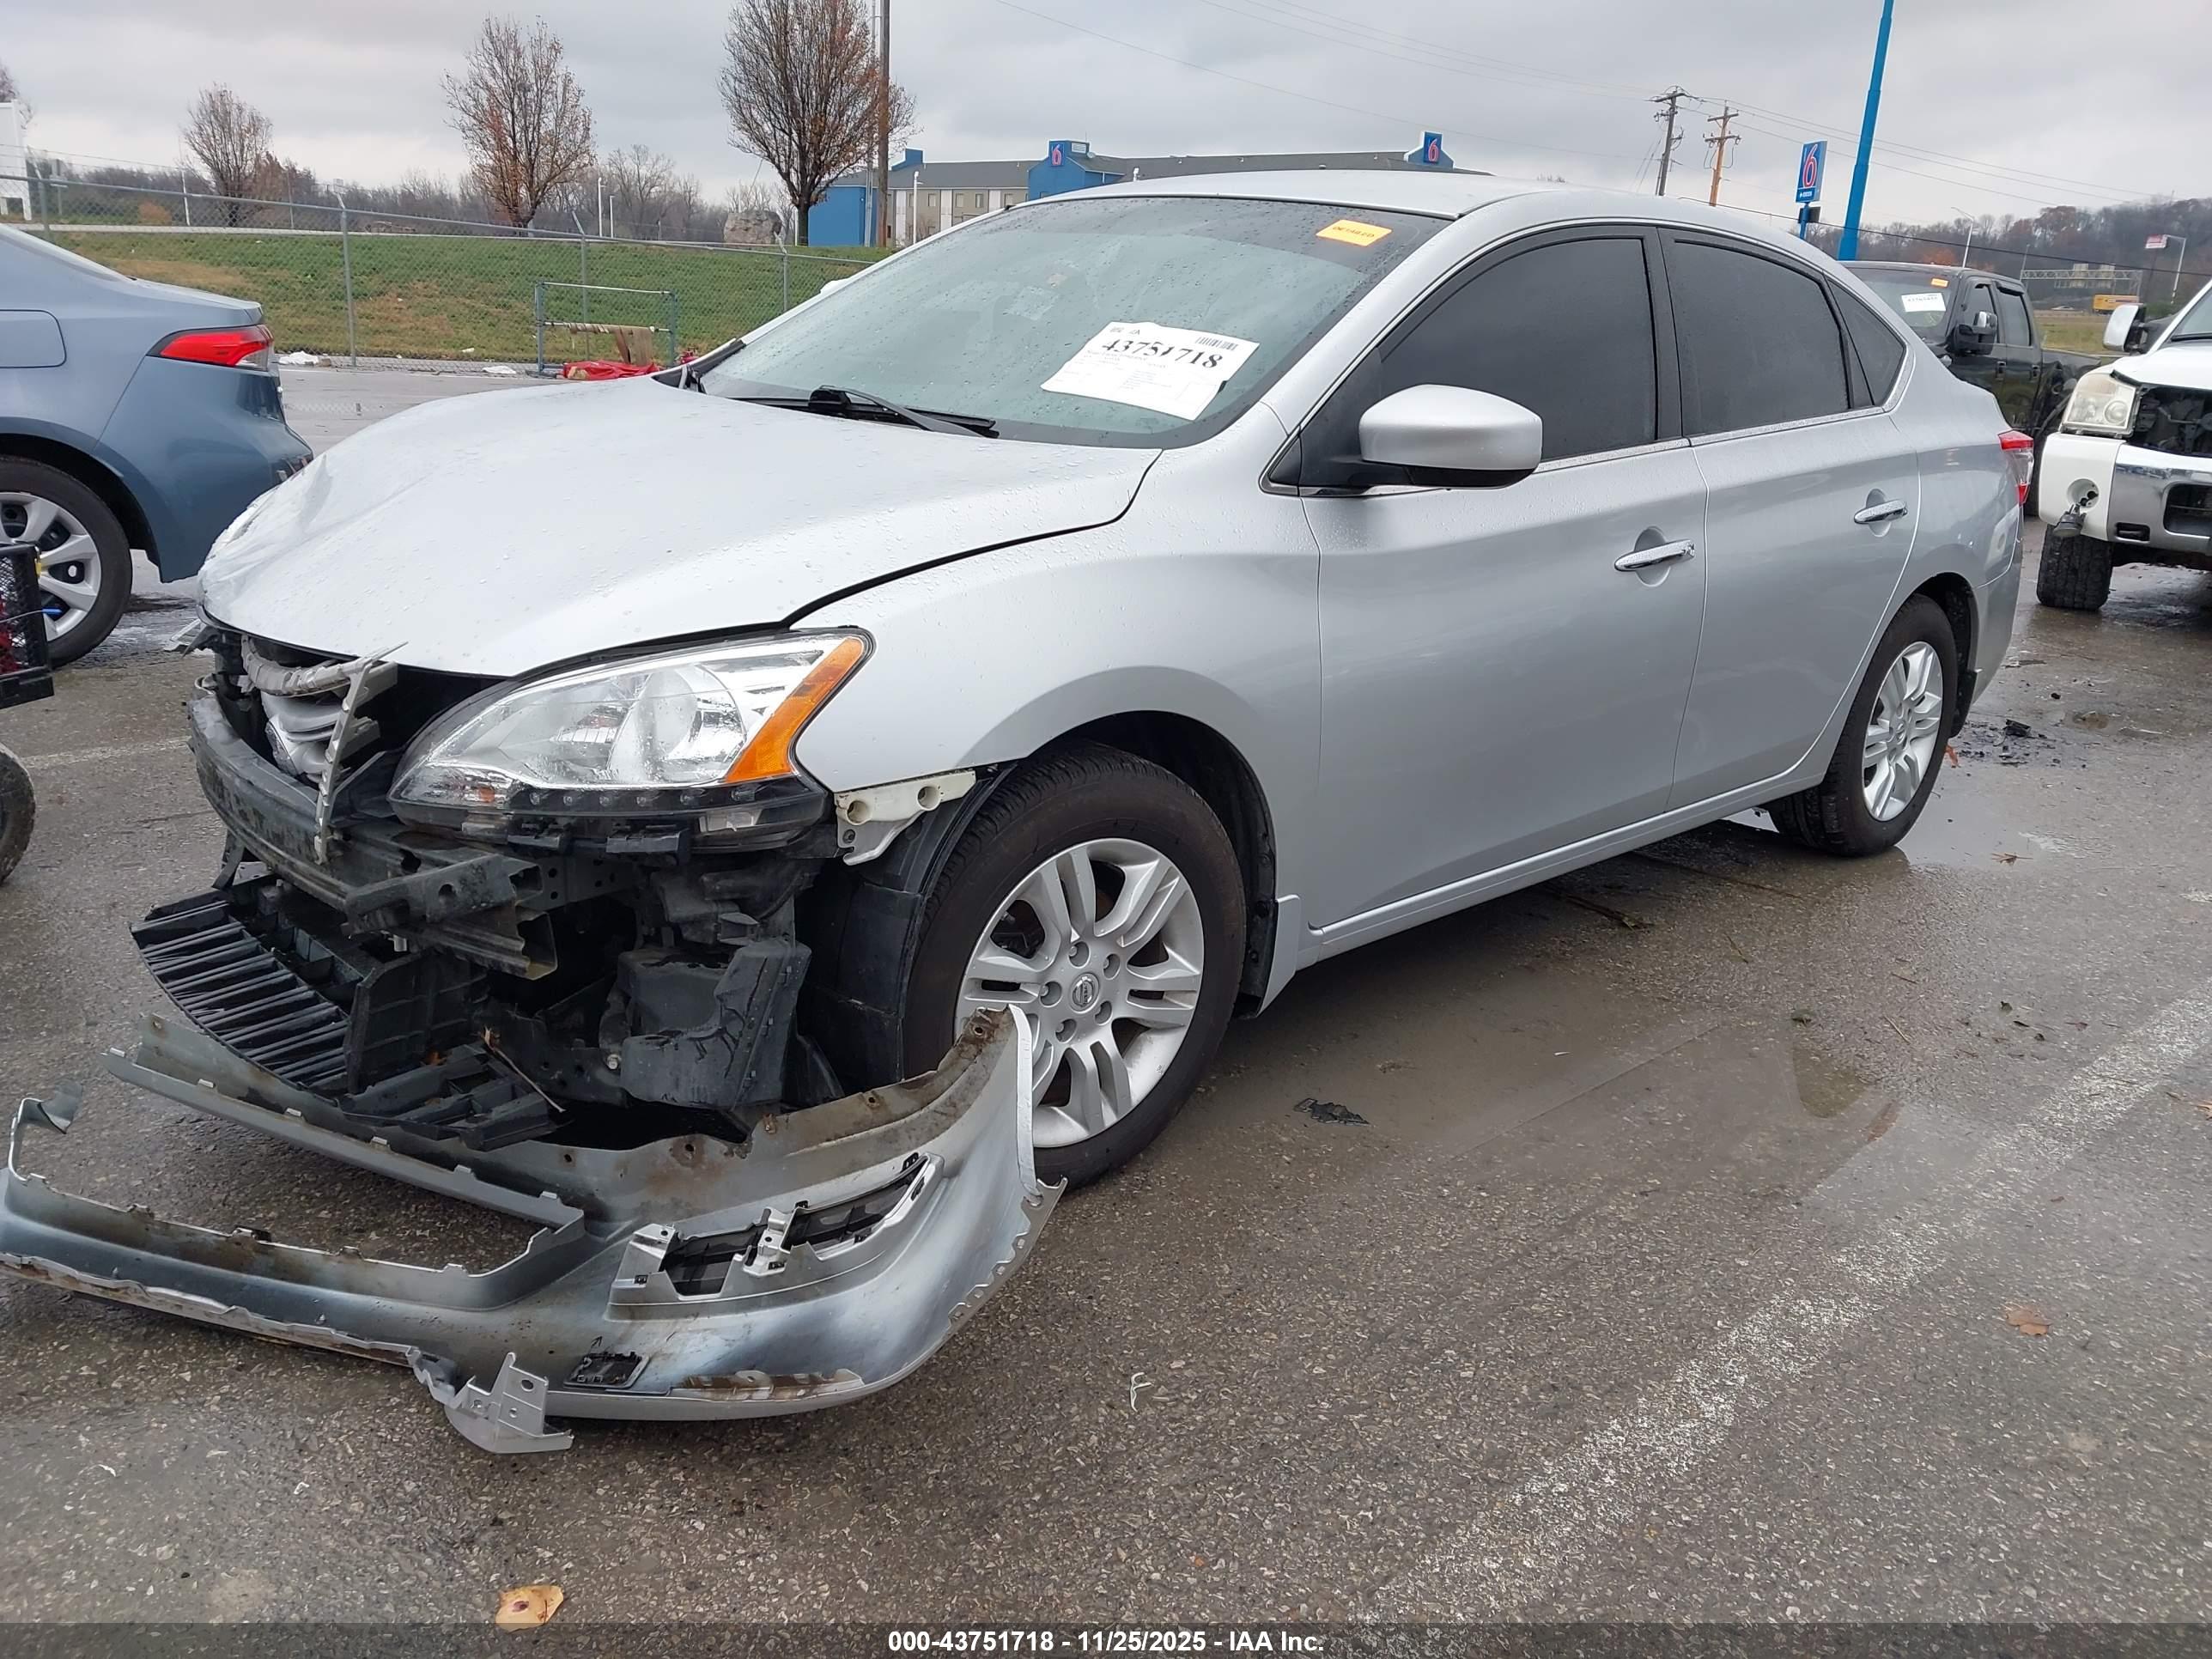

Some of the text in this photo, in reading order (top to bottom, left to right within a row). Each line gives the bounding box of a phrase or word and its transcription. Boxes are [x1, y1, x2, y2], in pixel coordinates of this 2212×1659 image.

[1052, 144, 1061, 165] 6
[1428, 137, 1439, 161] 6
[1802, 143, 1818, 188] 6
[1102, 339, 1223, 368] 43751718
